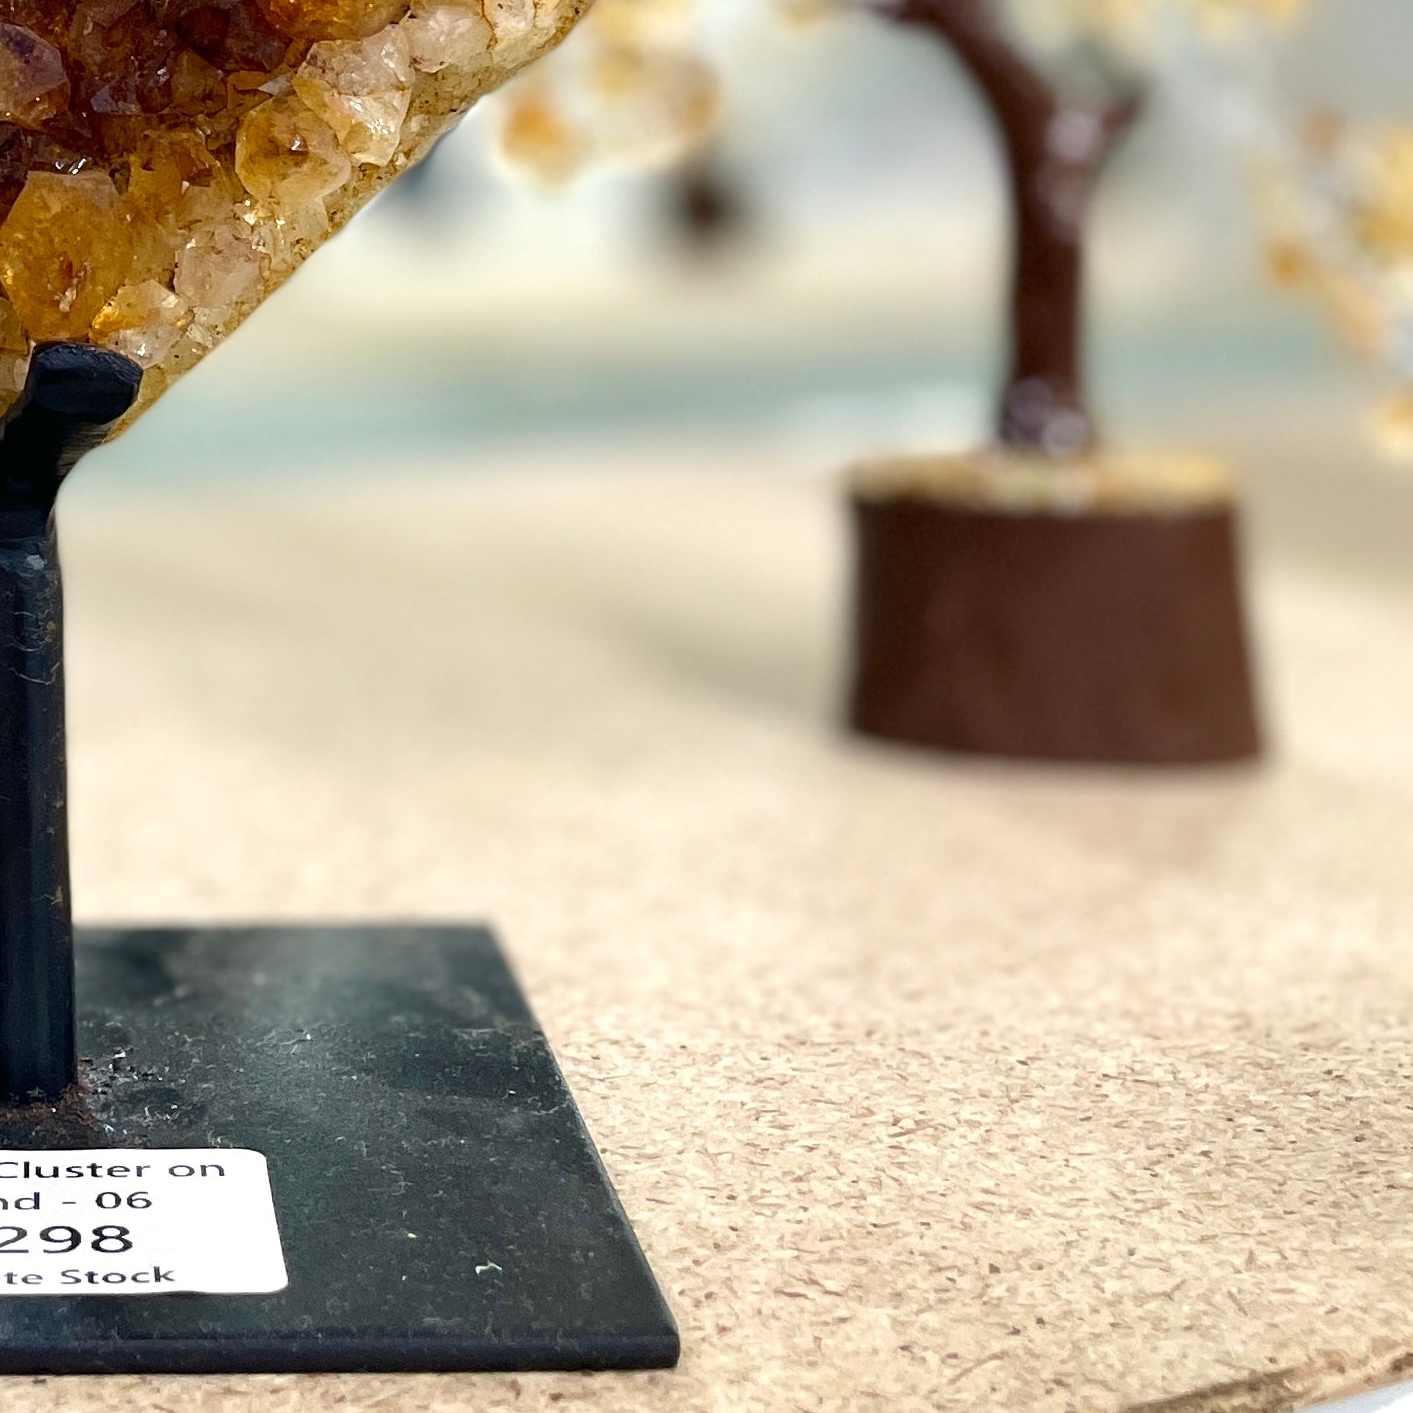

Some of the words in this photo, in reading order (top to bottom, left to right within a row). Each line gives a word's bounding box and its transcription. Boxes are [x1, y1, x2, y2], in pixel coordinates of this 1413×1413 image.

[168, 1162, 226, 1178] on
[95, 1191, 153, 1210] 06
[60, 1266, 176, 1285] Stock
